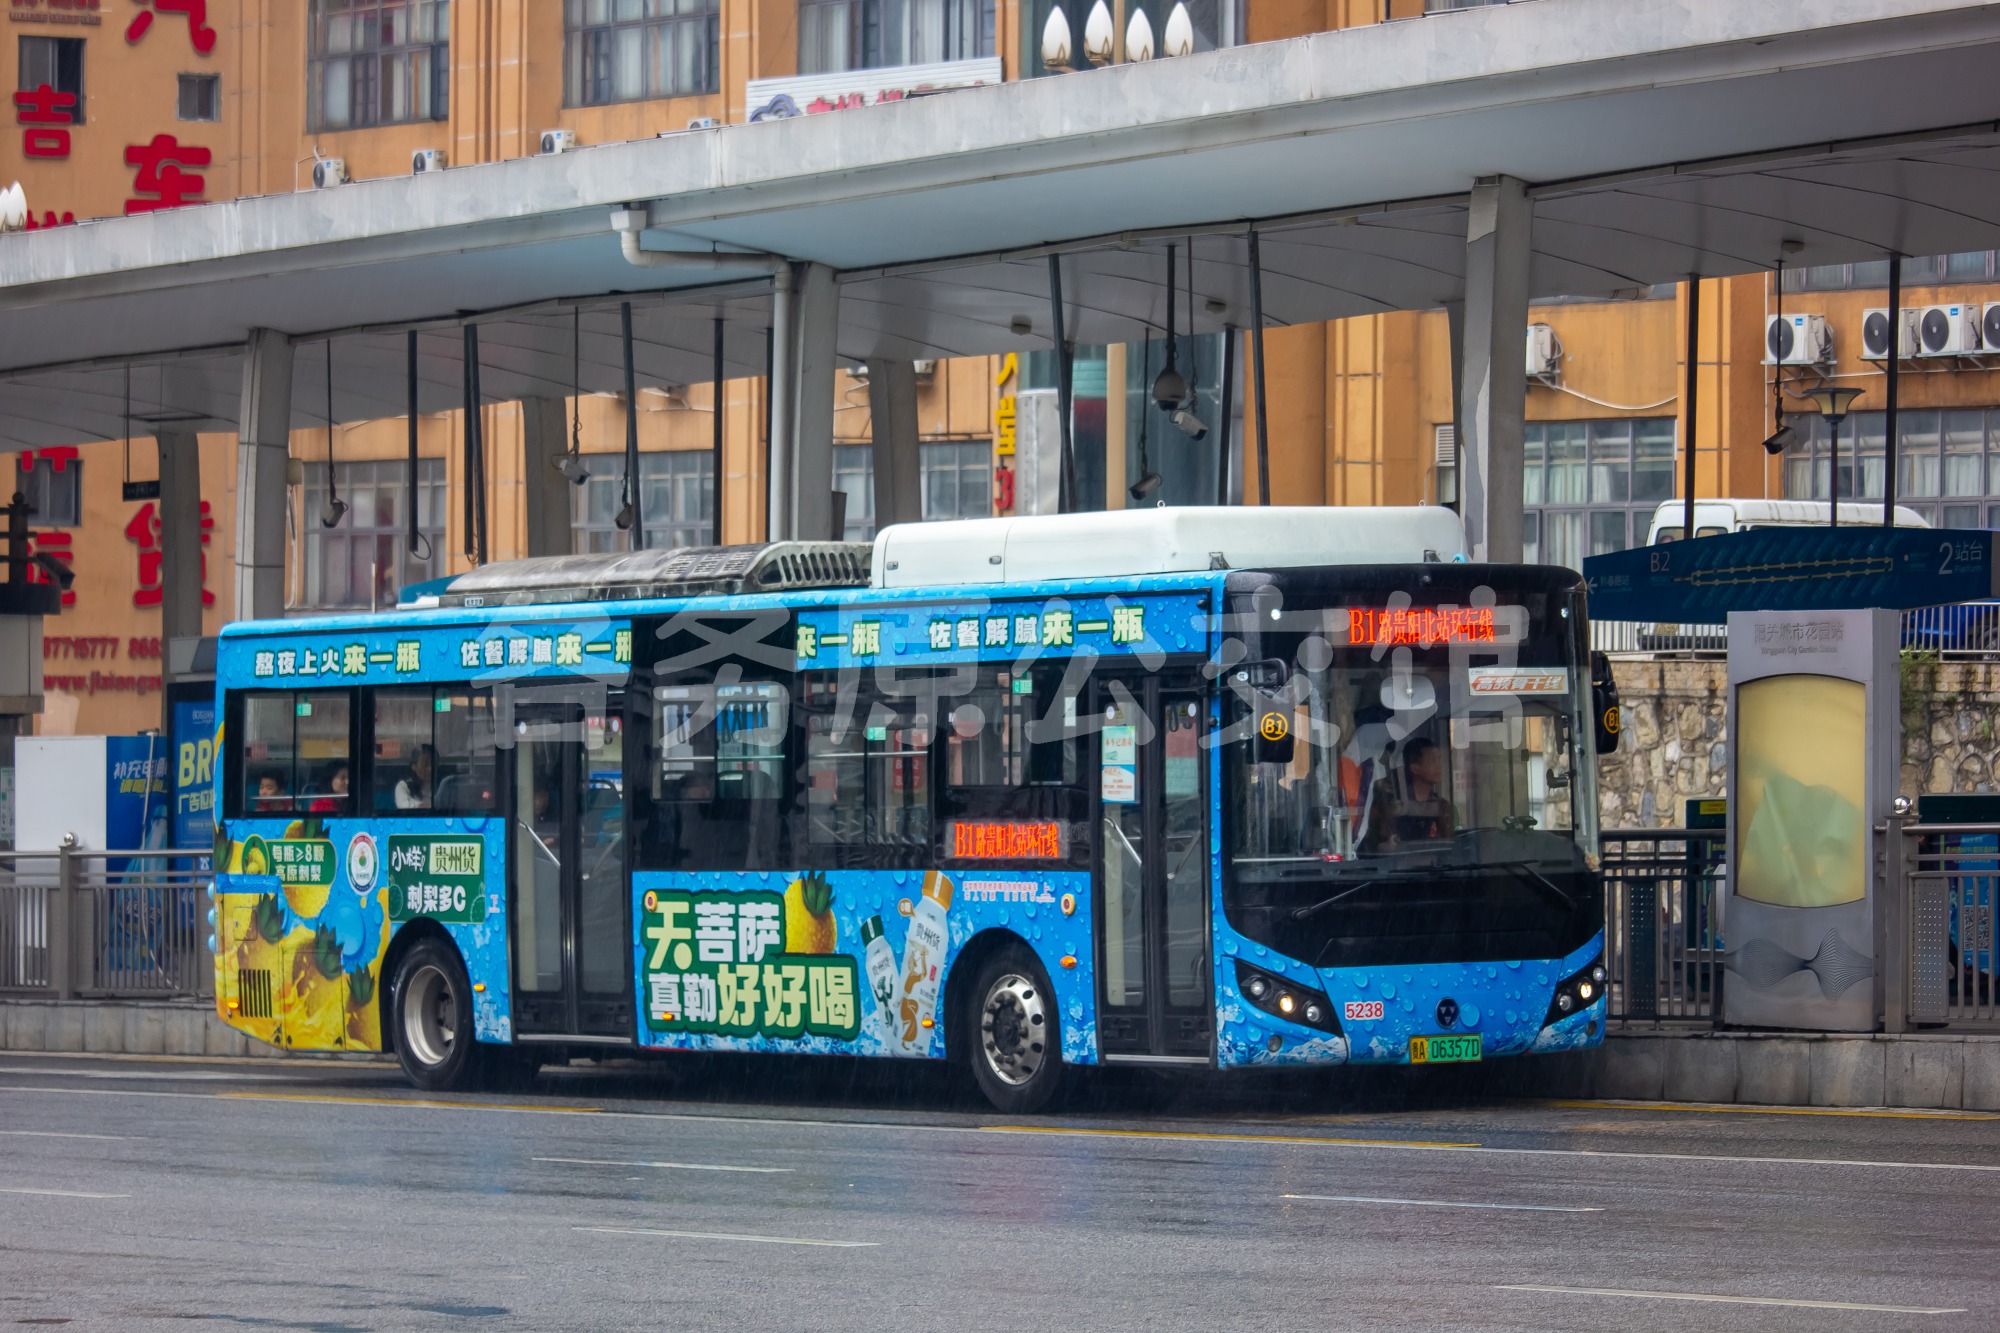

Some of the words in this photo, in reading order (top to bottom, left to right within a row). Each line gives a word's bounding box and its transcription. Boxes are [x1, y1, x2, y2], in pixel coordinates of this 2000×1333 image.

[1650, 551, 1670, 573] B2
[1938, 541, 1953, 575] 2
[1954, 539, 1984, 562] 站台
[929, 606, 1145, 649] 佐餐解腻来一瓶
[1753, 621, 1845, 644] 阳关城市花园站
[254, 640, 421, 677] 熬夜上火来一瓶
[1475, 675, 1562, 691] 高频骨干线
[1264, 720, 1284, 735] B1
[435, 845, 476, 873] 贵州货
[275, 864, 322, 882] 高原刺梨
[407, 881, 467, 914] 刺梨多C
[646, 900, 781, 970] 天菩萨
[648, 963, 856, 1031] 真勒好好喝
[1345, 1002, 1384, 1019] 5238
